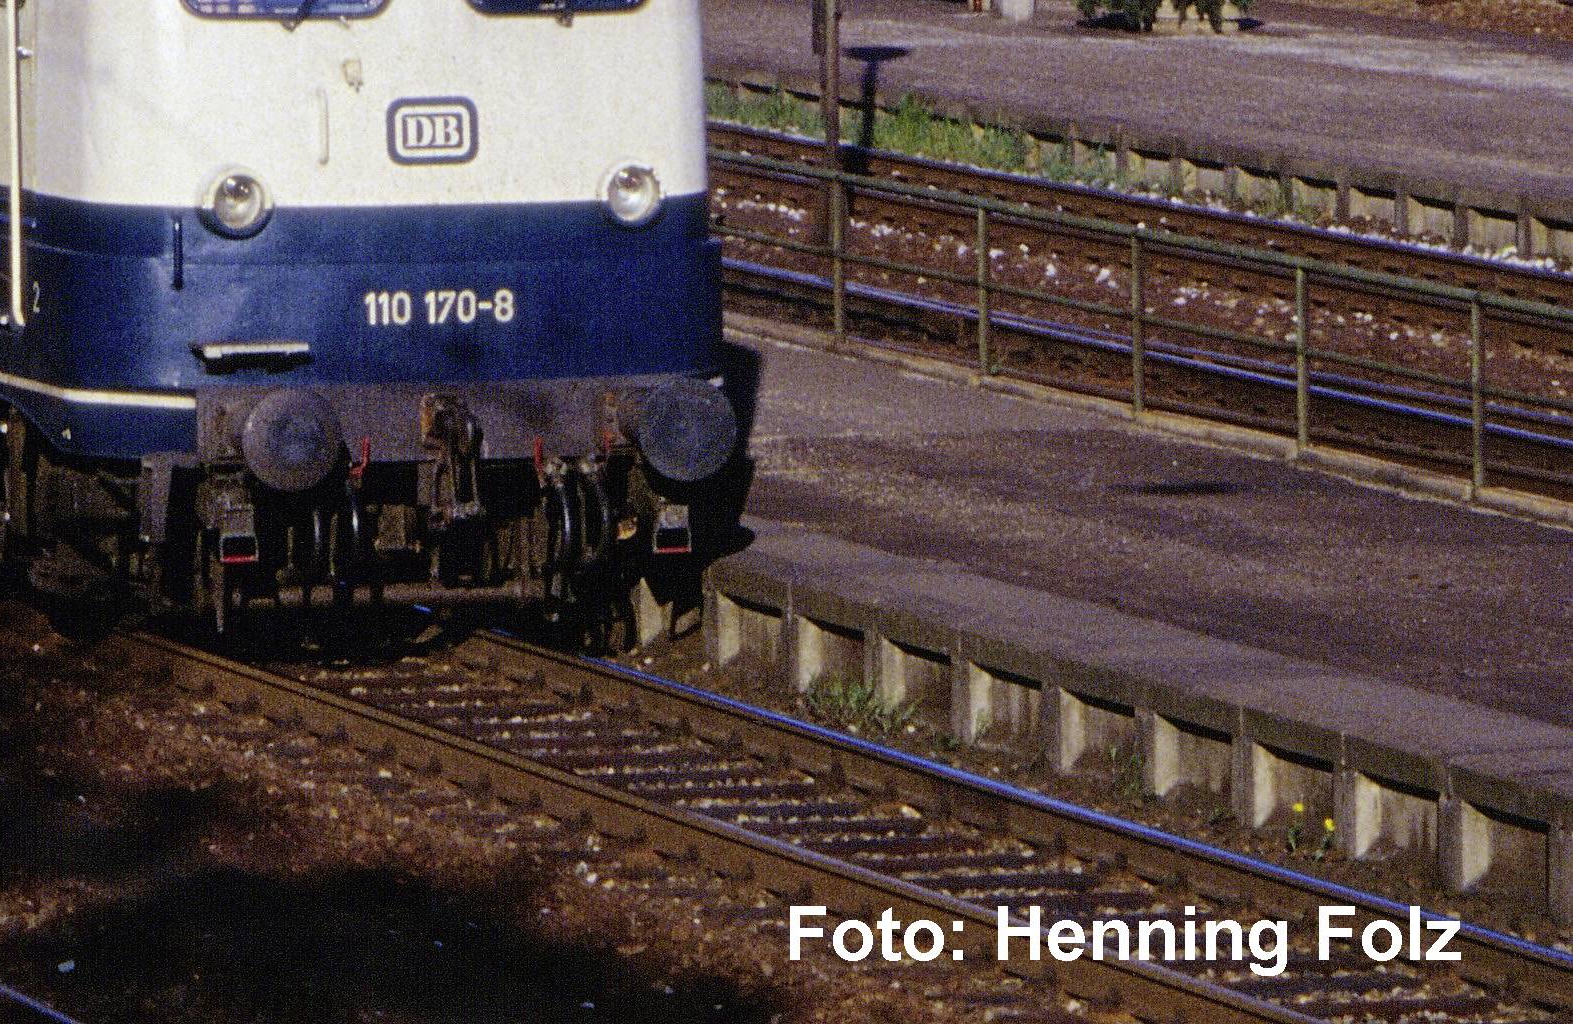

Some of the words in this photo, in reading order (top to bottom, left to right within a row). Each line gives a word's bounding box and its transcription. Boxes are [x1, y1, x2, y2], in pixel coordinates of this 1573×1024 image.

[402, 114, 462, 149] DB
[364, 291, 412, 326] 110
[425, 288, 515, 324] 170-8
